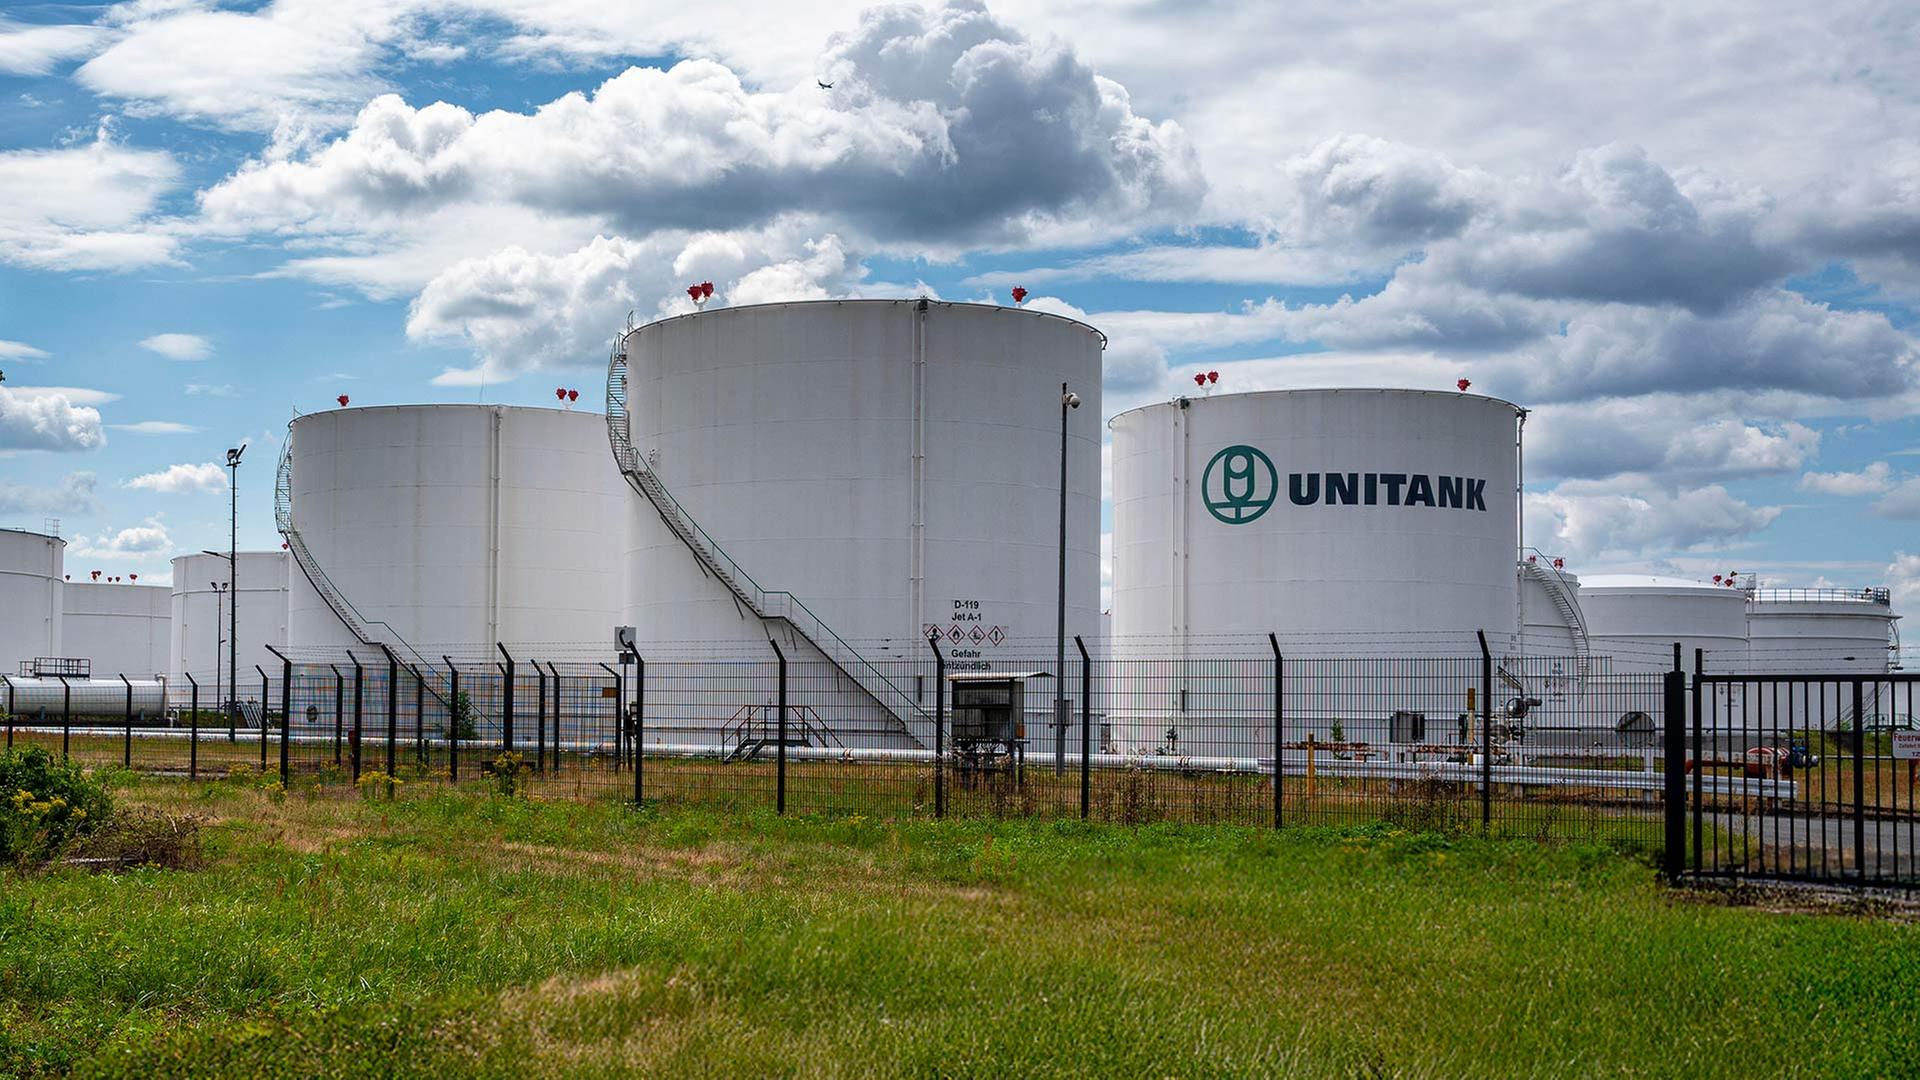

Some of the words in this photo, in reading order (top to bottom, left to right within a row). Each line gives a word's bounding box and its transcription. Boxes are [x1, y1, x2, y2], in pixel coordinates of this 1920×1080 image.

[1288, 473, 1487, 511] UNITANK
[954, 600, 979, 609] D-119
[951, 612, 966, 621] Jet
[967, 613, 982, 621] A-1
[951, 649, 981, 658] Gefahr
